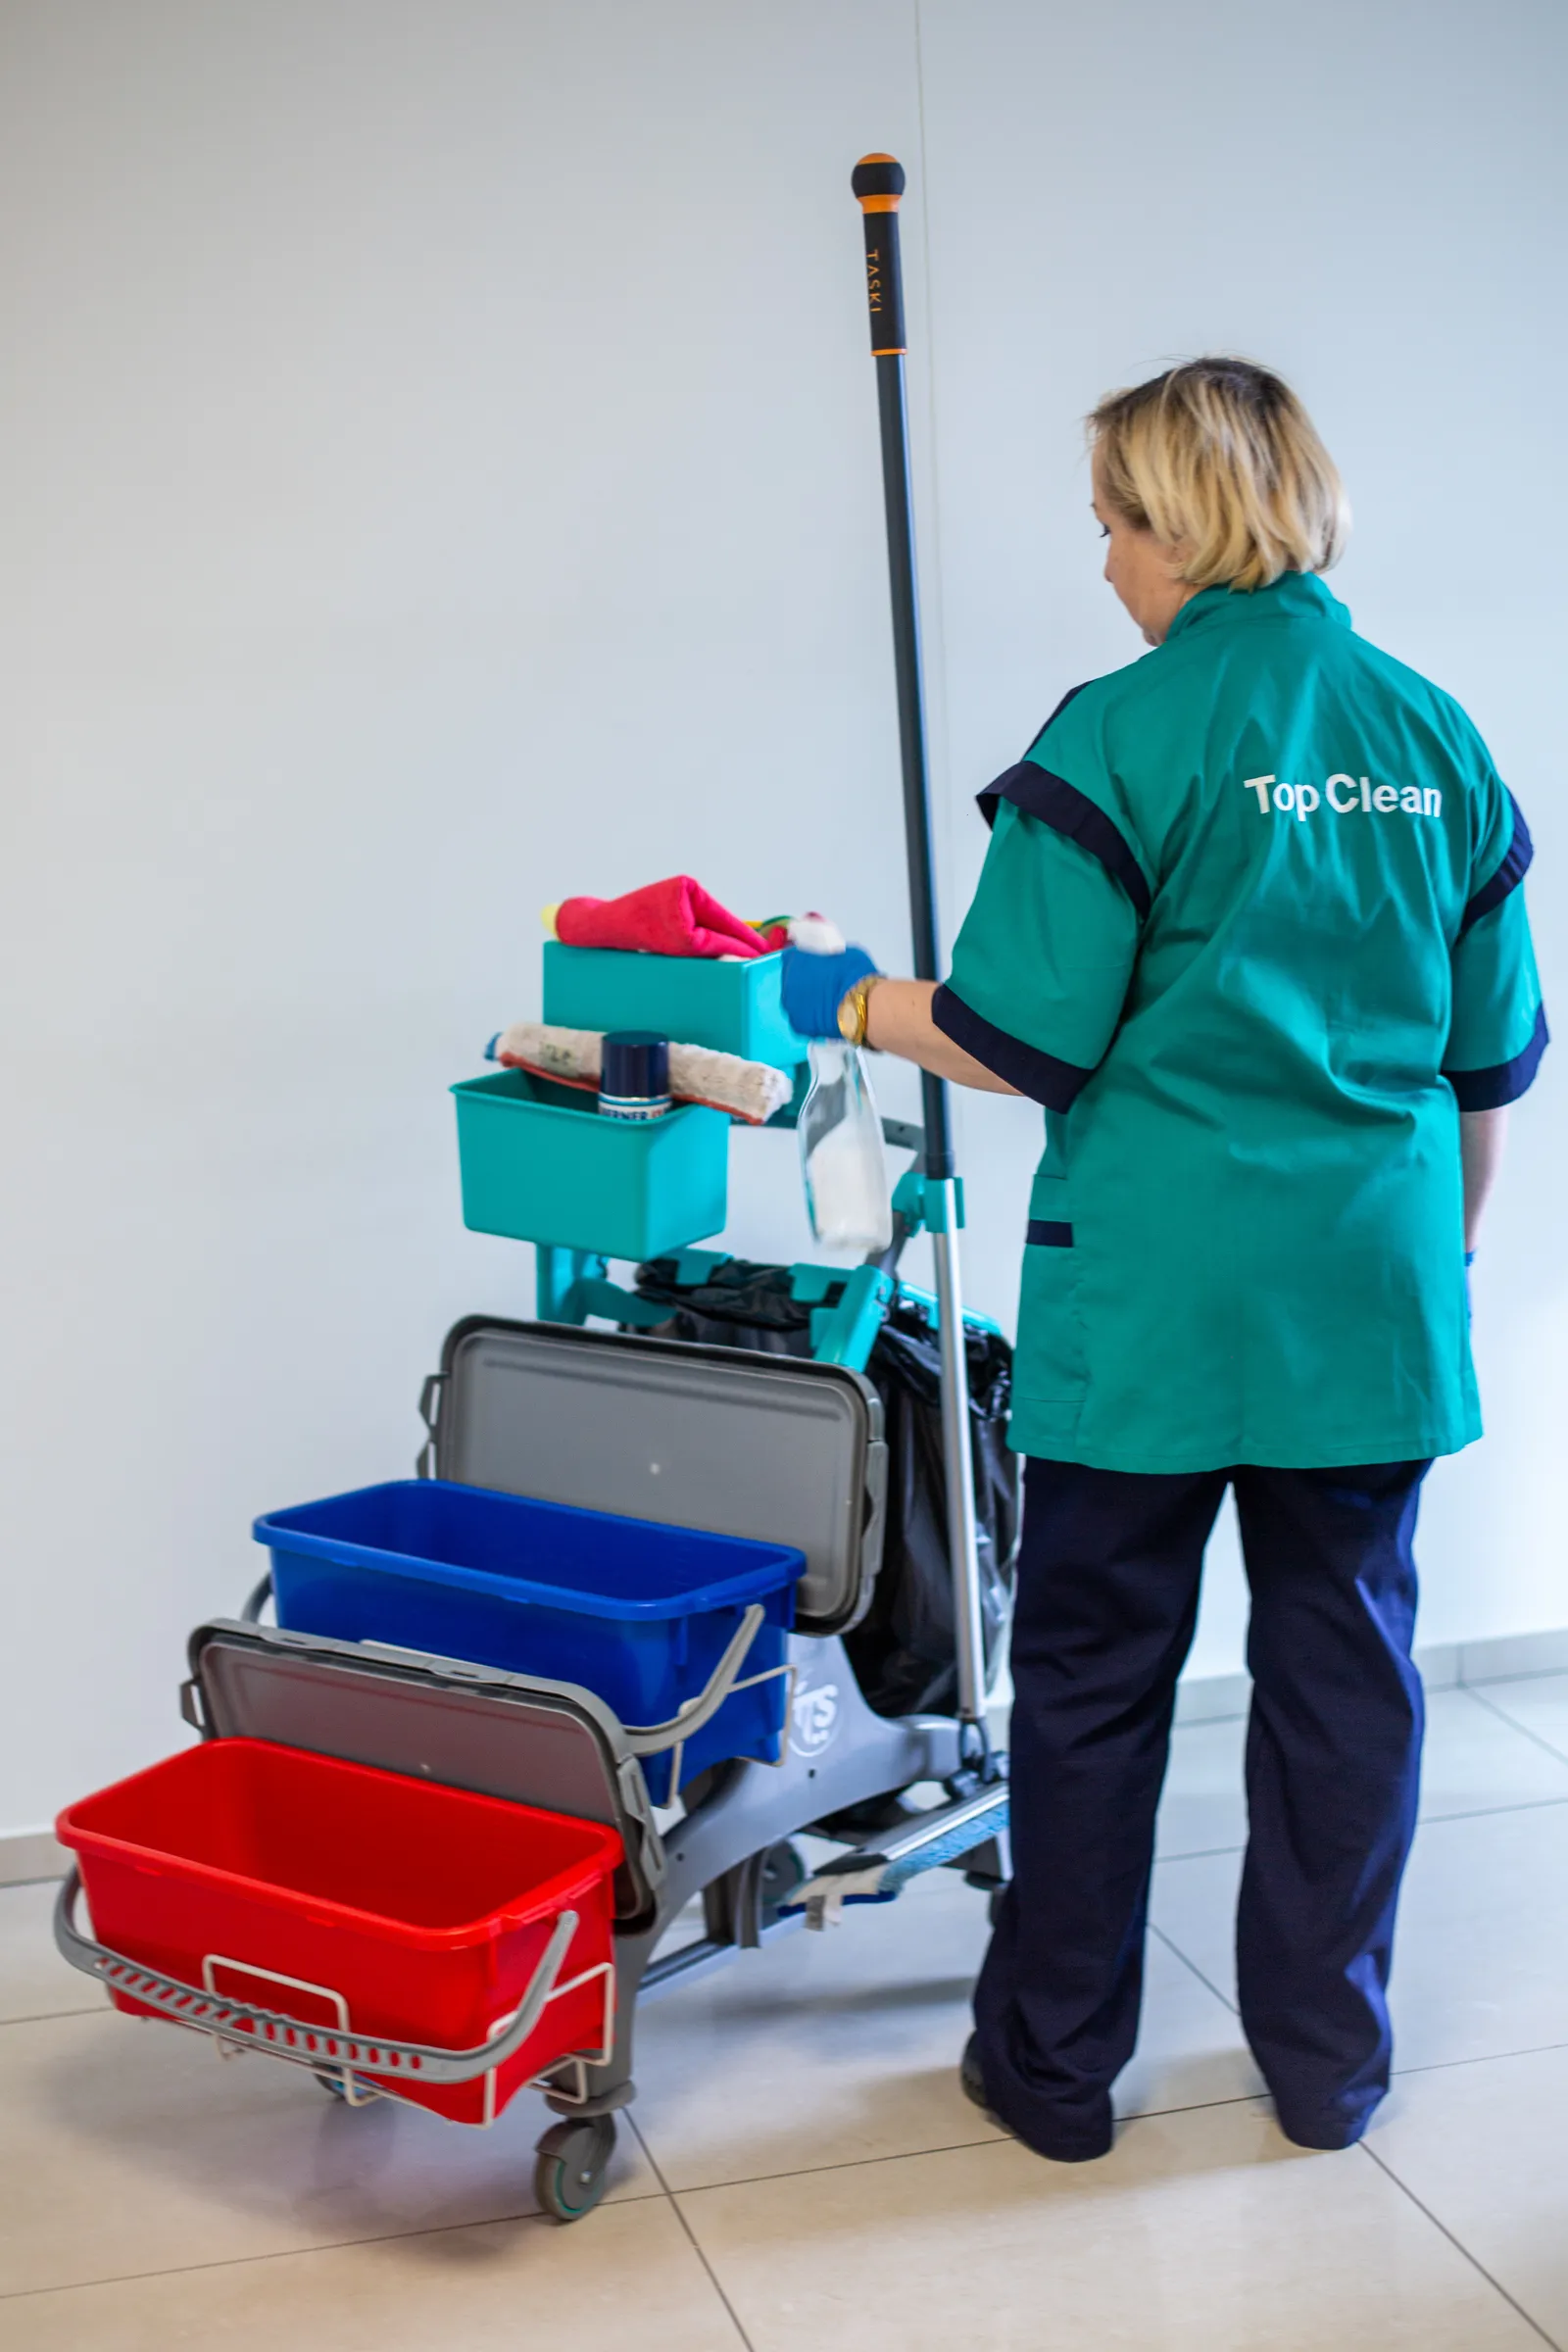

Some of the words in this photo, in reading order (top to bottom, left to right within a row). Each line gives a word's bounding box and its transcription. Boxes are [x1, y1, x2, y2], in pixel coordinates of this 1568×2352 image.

[865, 249, 883, 313] TASKI
[1244, 774, 1320, 821] Top
[1325, 773, 1443, 818] Clean
